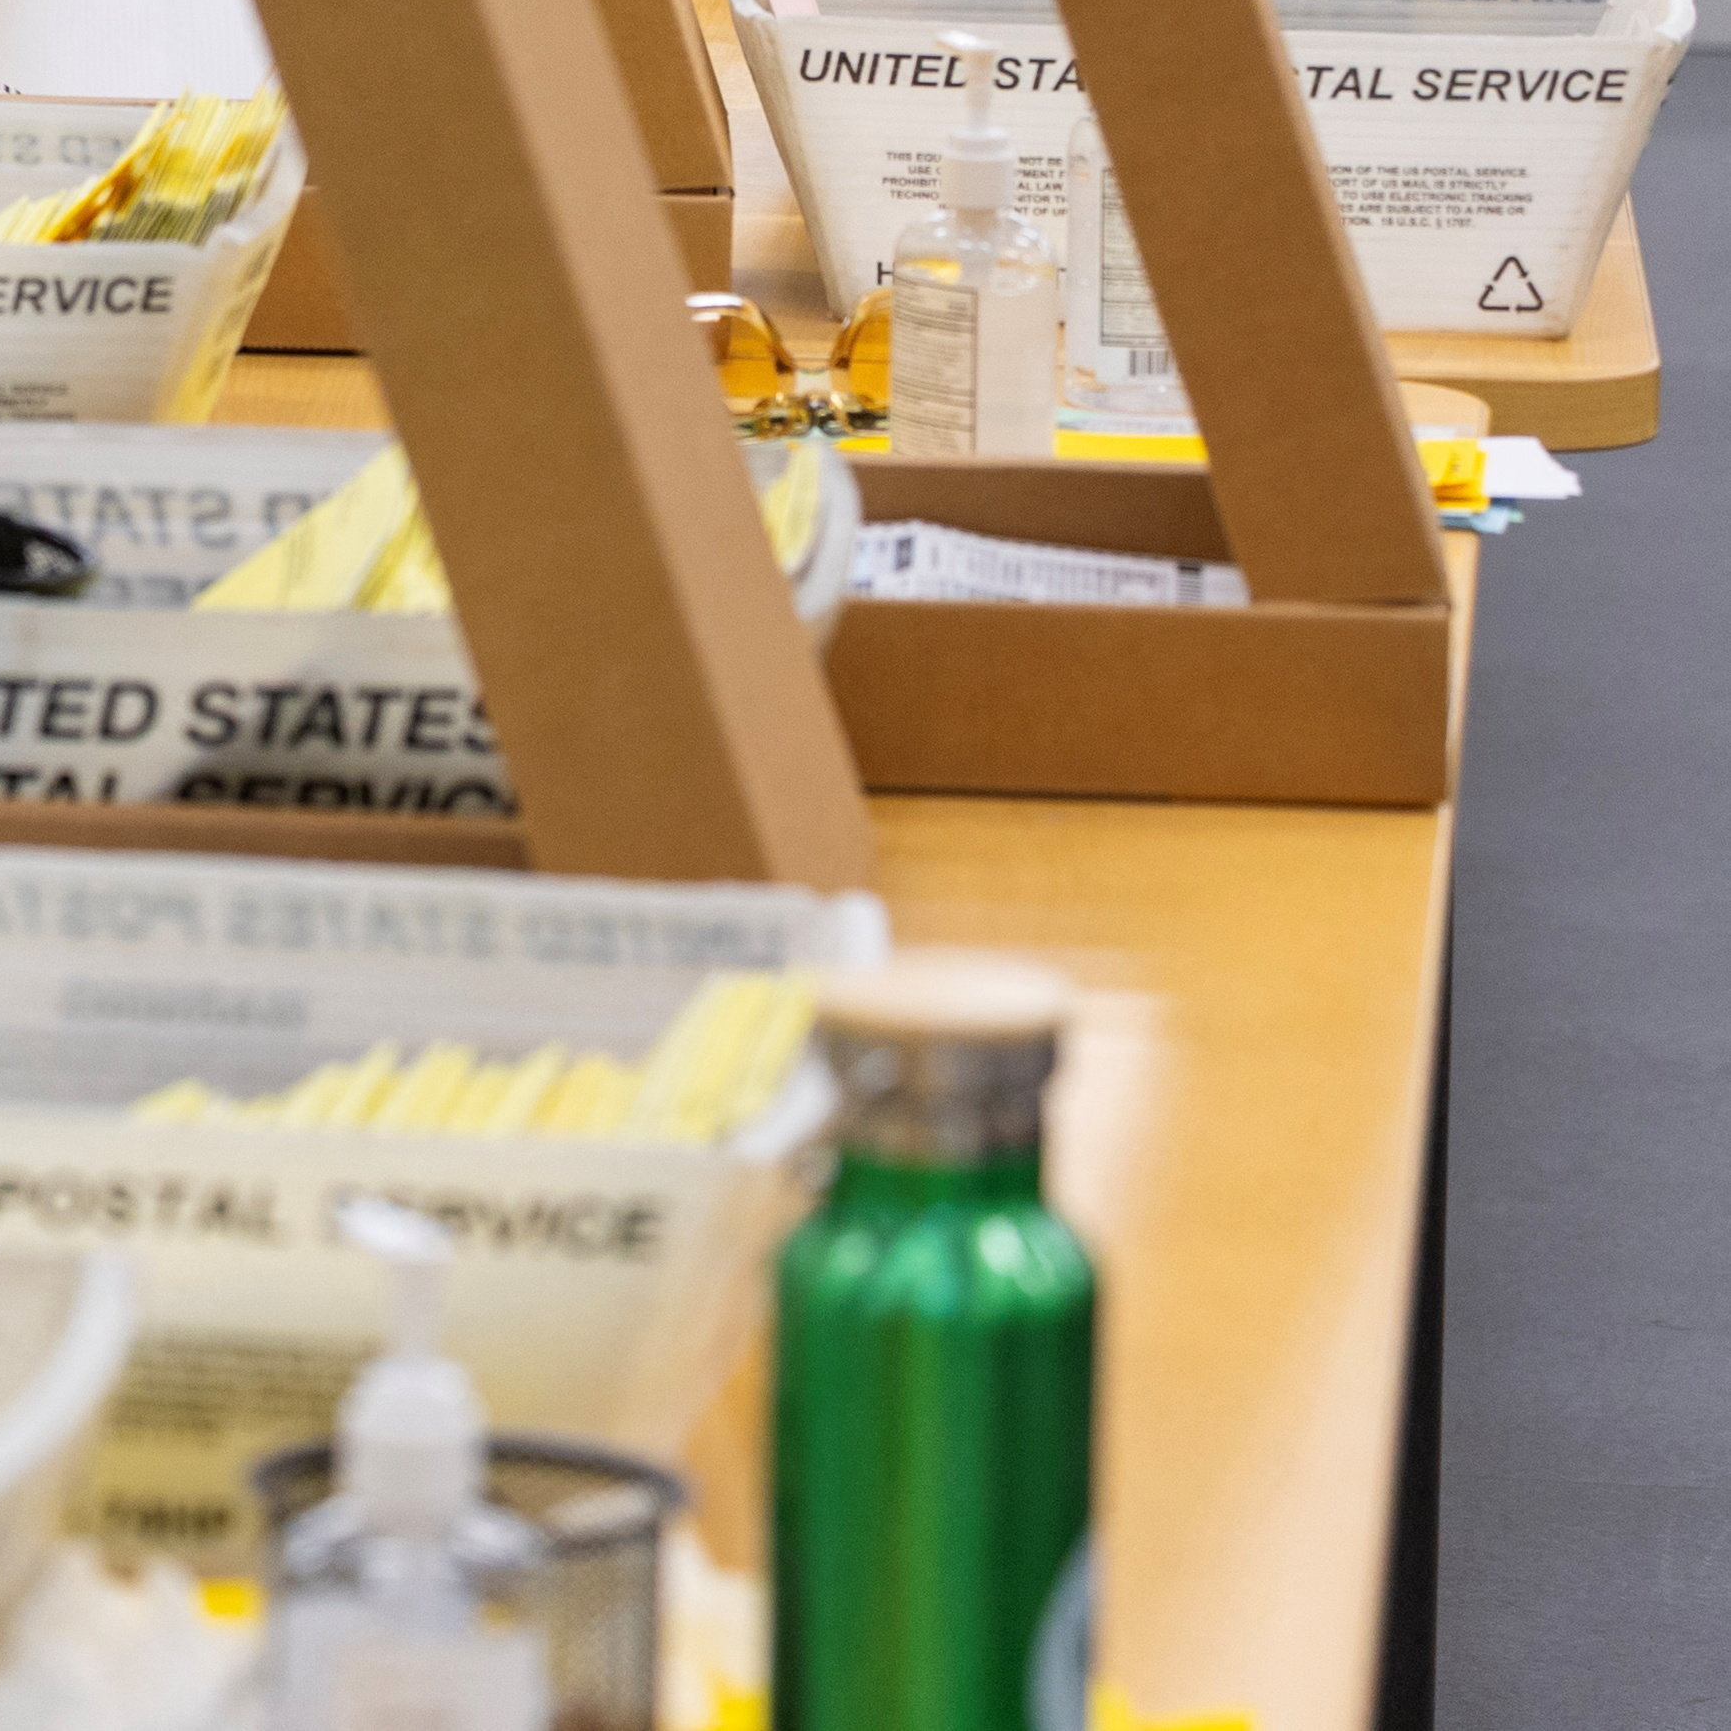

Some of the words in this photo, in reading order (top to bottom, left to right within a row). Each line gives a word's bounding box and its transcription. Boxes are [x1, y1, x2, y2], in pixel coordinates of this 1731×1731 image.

[994, 57, 1086, 91] STA
[1304, 66, 1393, 100] TAL
[1412, 69, 1629, 103] SERVICE
[1402, 180, 1431, 191] MAIL
[1449, 181, 1508, 192] STRICTLY
[1422, 167, 1470, 179] POSTAL
[882, 177, 941, 188] PROHIBIT
[1389, 192, 1467, 204] ELECTRONIC
[1471, 193, 1533, 205] TRACKING
[890, 189, 939, 201] TECHNO
[1387, 205, 1442, 216] SUBJECT
